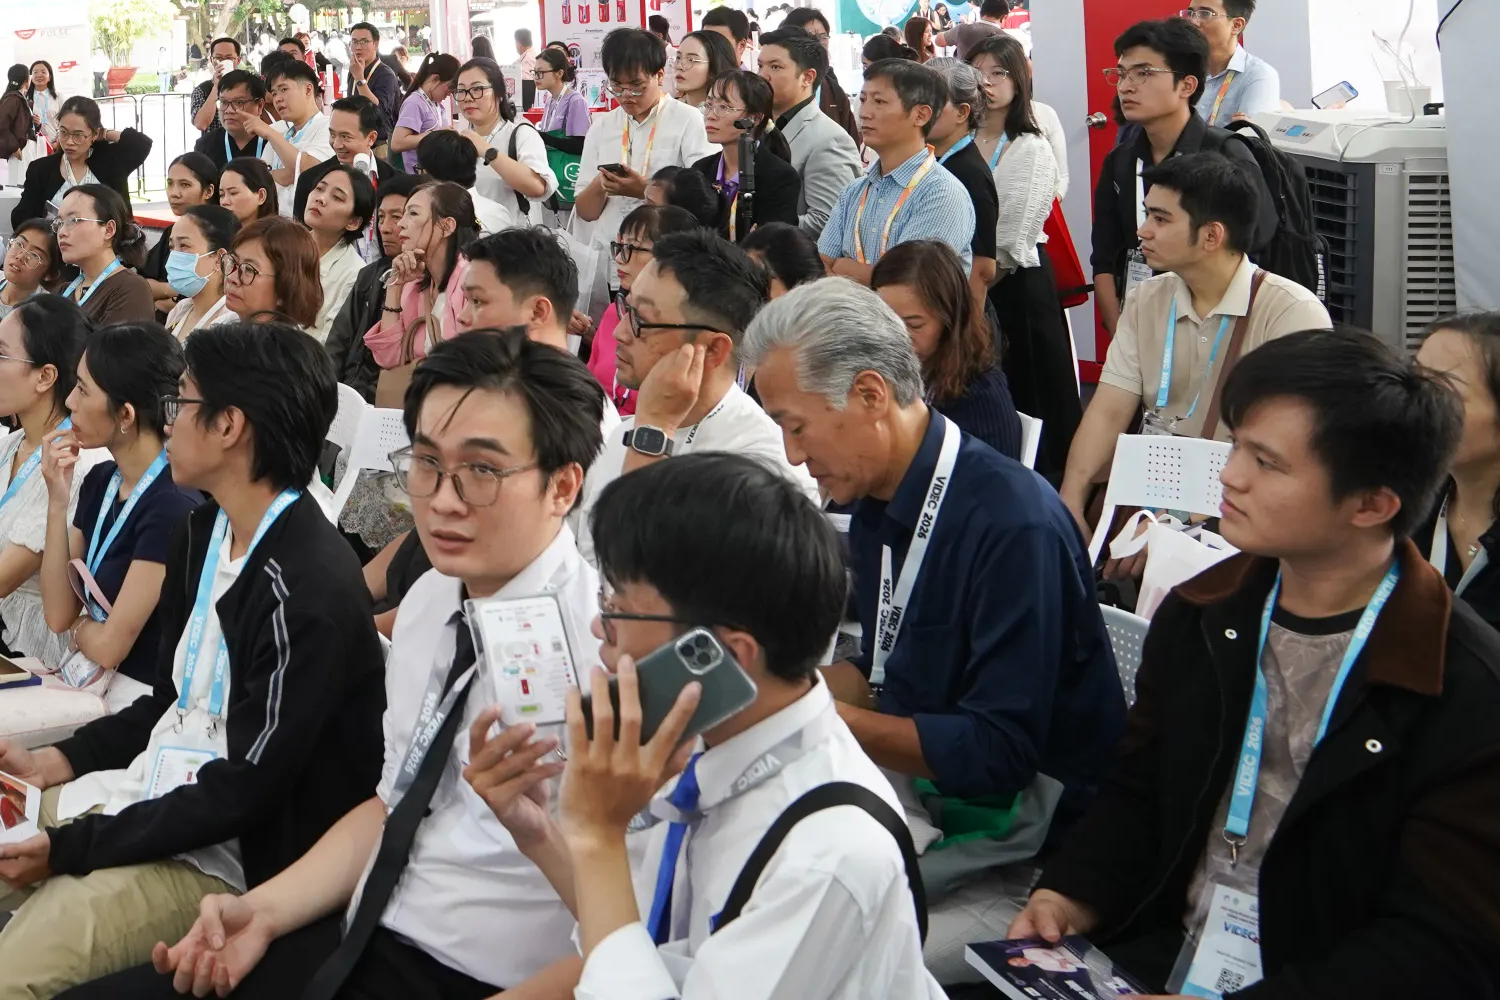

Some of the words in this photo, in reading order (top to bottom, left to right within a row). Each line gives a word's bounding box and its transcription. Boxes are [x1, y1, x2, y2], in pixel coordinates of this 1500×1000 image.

[927, 476, 947, 510] VIDEC
[917, 512, 933, 540] 2026
[882, 578, 891, 606] 2026
[190, 615, 204, 649] VIDEC
[888, 605, 903, 633] VIDEC
[880, 630, 895, 654] 2026
[184, 652, 197, 680] 2026
[419, 710, 445, 746] VIDEC
[1245, 716, 1263, 752] 2026
[404, 745, 424, 776] 2026
[737, 753, 783, 791] VIDEC
[1235, 752, 1257, 797] VIDEC
